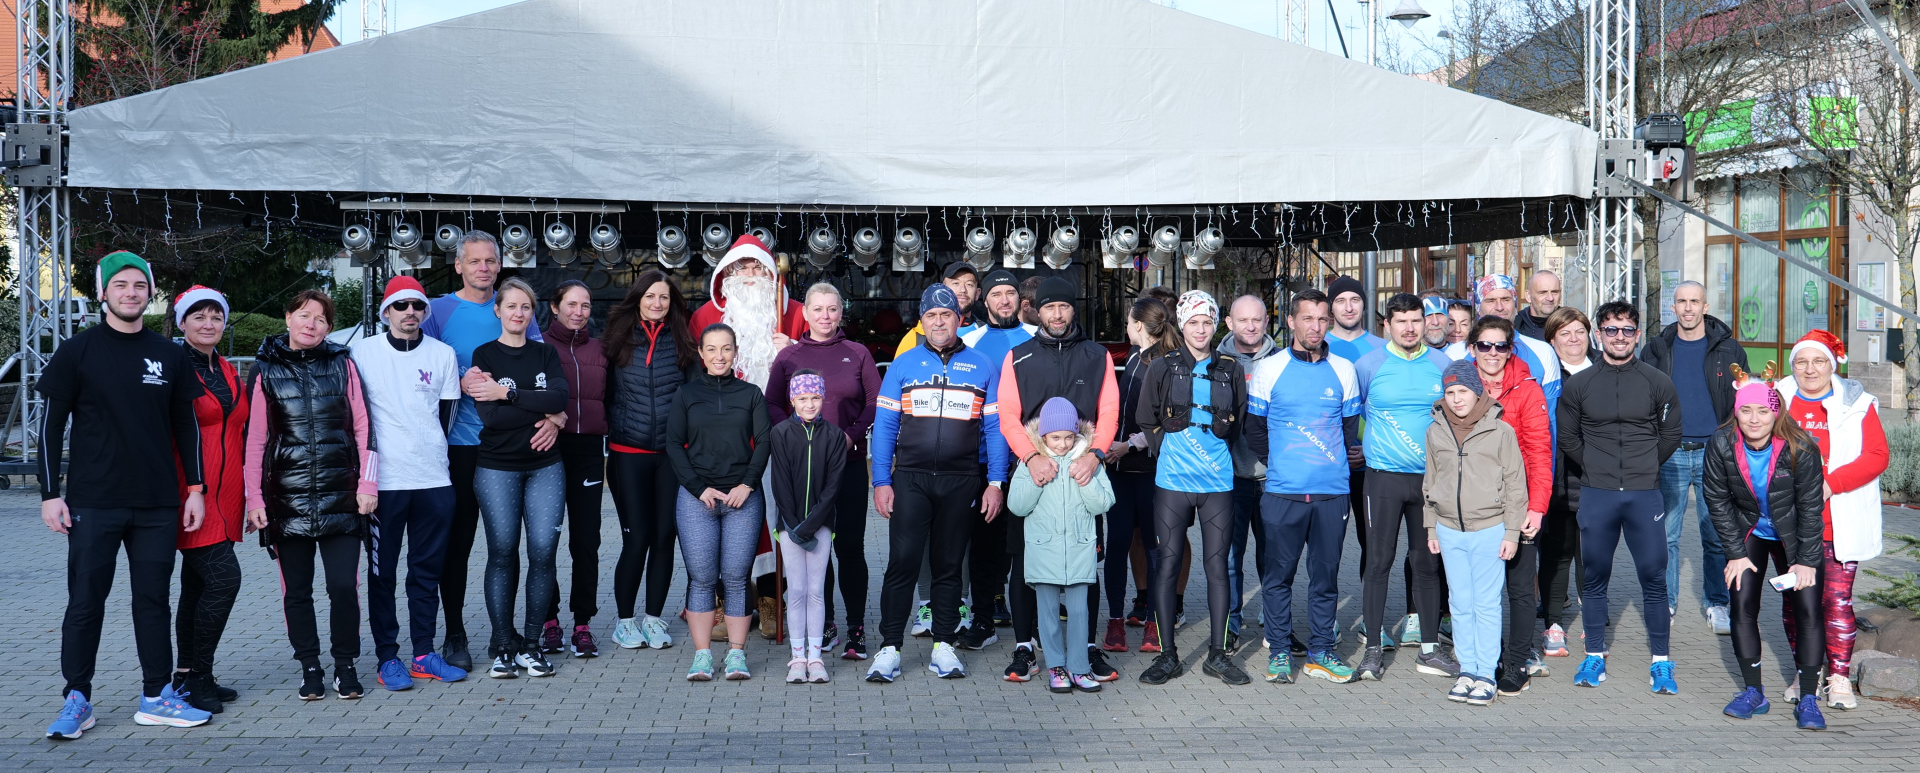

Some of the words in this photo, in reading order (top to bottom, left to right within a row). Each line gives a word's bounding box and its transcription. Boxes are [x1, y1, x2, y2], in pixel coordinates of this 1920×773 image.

[947, 400, 970, 410] Center
[1381, 410, 1425, 456] SZALADÓK
[1325, 451, 1337, 462] SE
[1210, 461, 1222, 472] SE
[369, 522, 381, 577] Zeus
